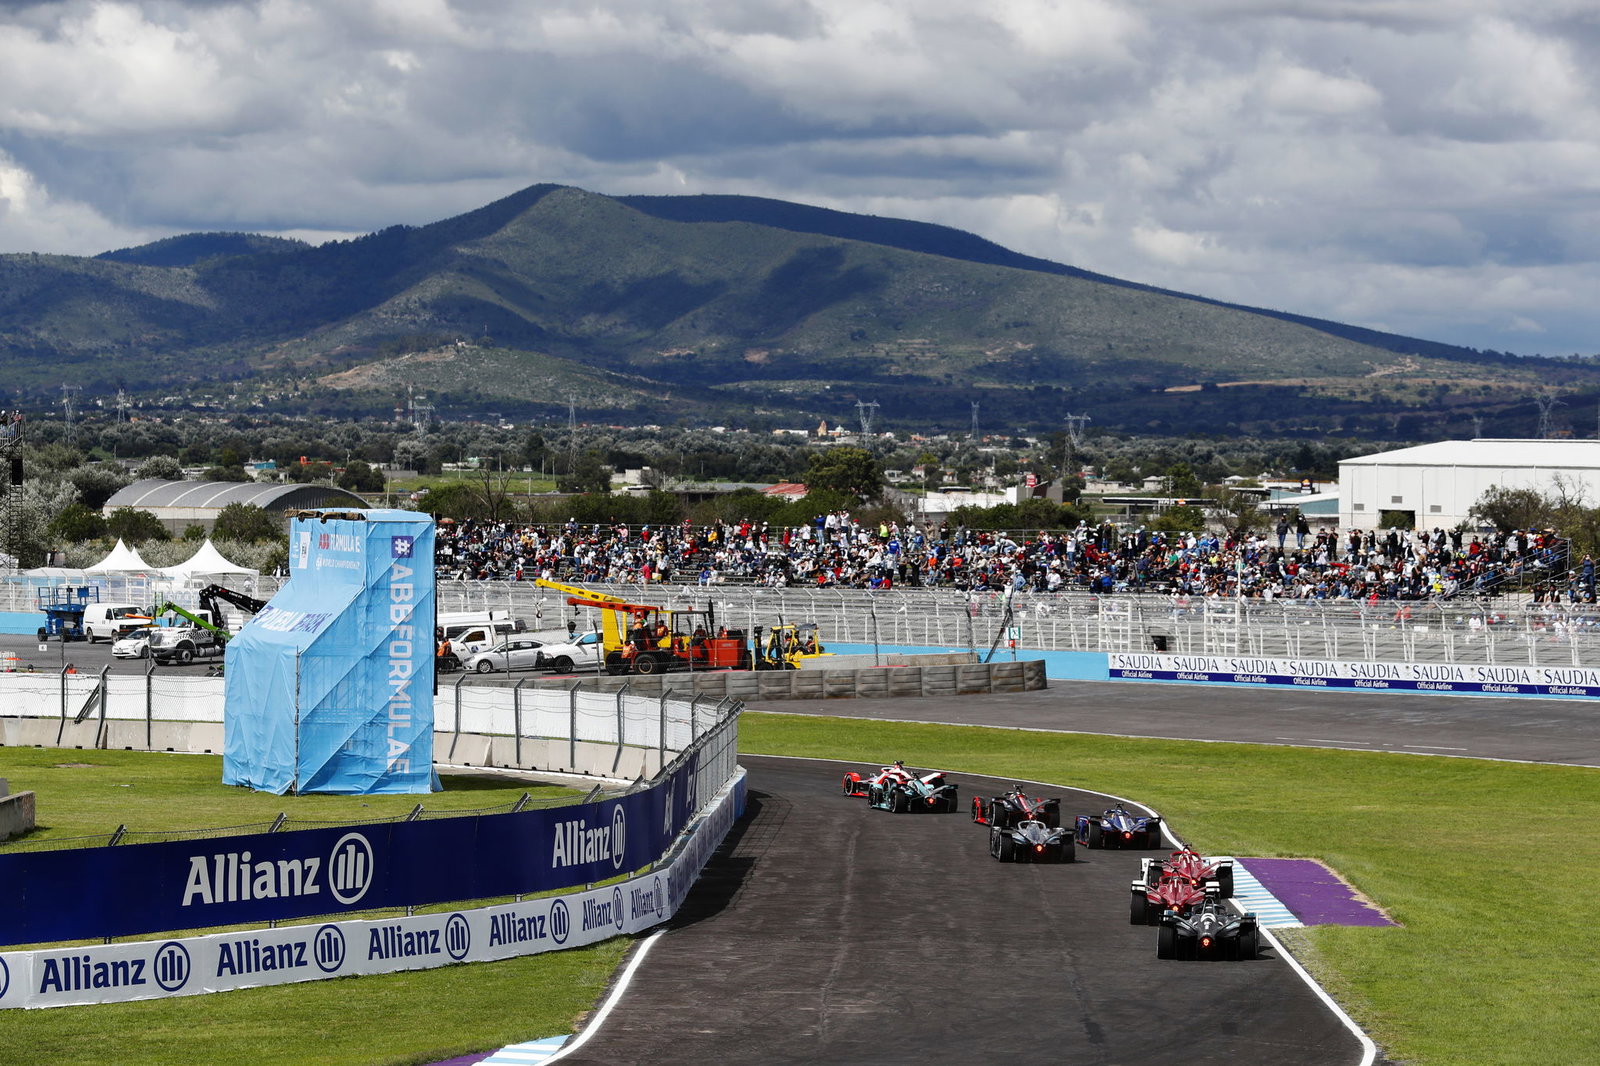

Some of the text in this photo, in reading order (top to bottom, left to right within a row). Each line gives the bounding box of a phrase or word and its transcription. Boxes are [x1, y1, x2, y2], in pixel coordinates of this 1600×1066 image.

[318, 533, 330, 550] ABB
[331, 534, 354, 552] FORMULA
[355, 536, 361, 552] E
[1119, 655, 1163, 669] SAUDIA
[1174, 657, 1219, 671] SAUDIA
[1231, 658, 1278, 674] SAUDIA
[1290, 661, 1338, 676] SAUDIA
[1122, 670, 1153, 679] Official Airline
[1176, 672, 1209, 681] Official Airline
[1234, 674, 1267, 683] Official Airline
[1350, 664, 1400, 678] SAUDIA
[1413, 665, 1464, 680] SAUDIA
[1478, 667, 1530, 682] SAUDIA
[1544, 669, 1599, 685] SAUDIA
[1293, 677, 1327, 686] Official Airline
[1354, 680, 1389, 688] Official Airline
[1416, 682, 1452, 690] Official Airline
[1482, 684, 1518, 693] Official Airline
[1549, 686, 1586, 696] Official Airline
[553, 820, 610, 868] Allianz
[182, 851, 320, 906] Allianz
[631, 888, 655, 920] Allianz
[582, 897, 612, 931] Allianz
[489, 912, 546, 947] Allianz
[368, 925, 441, 961] Allianz
[217, 939, 308, 977] Allianz
[40, 955, 146, 994] Allianz
